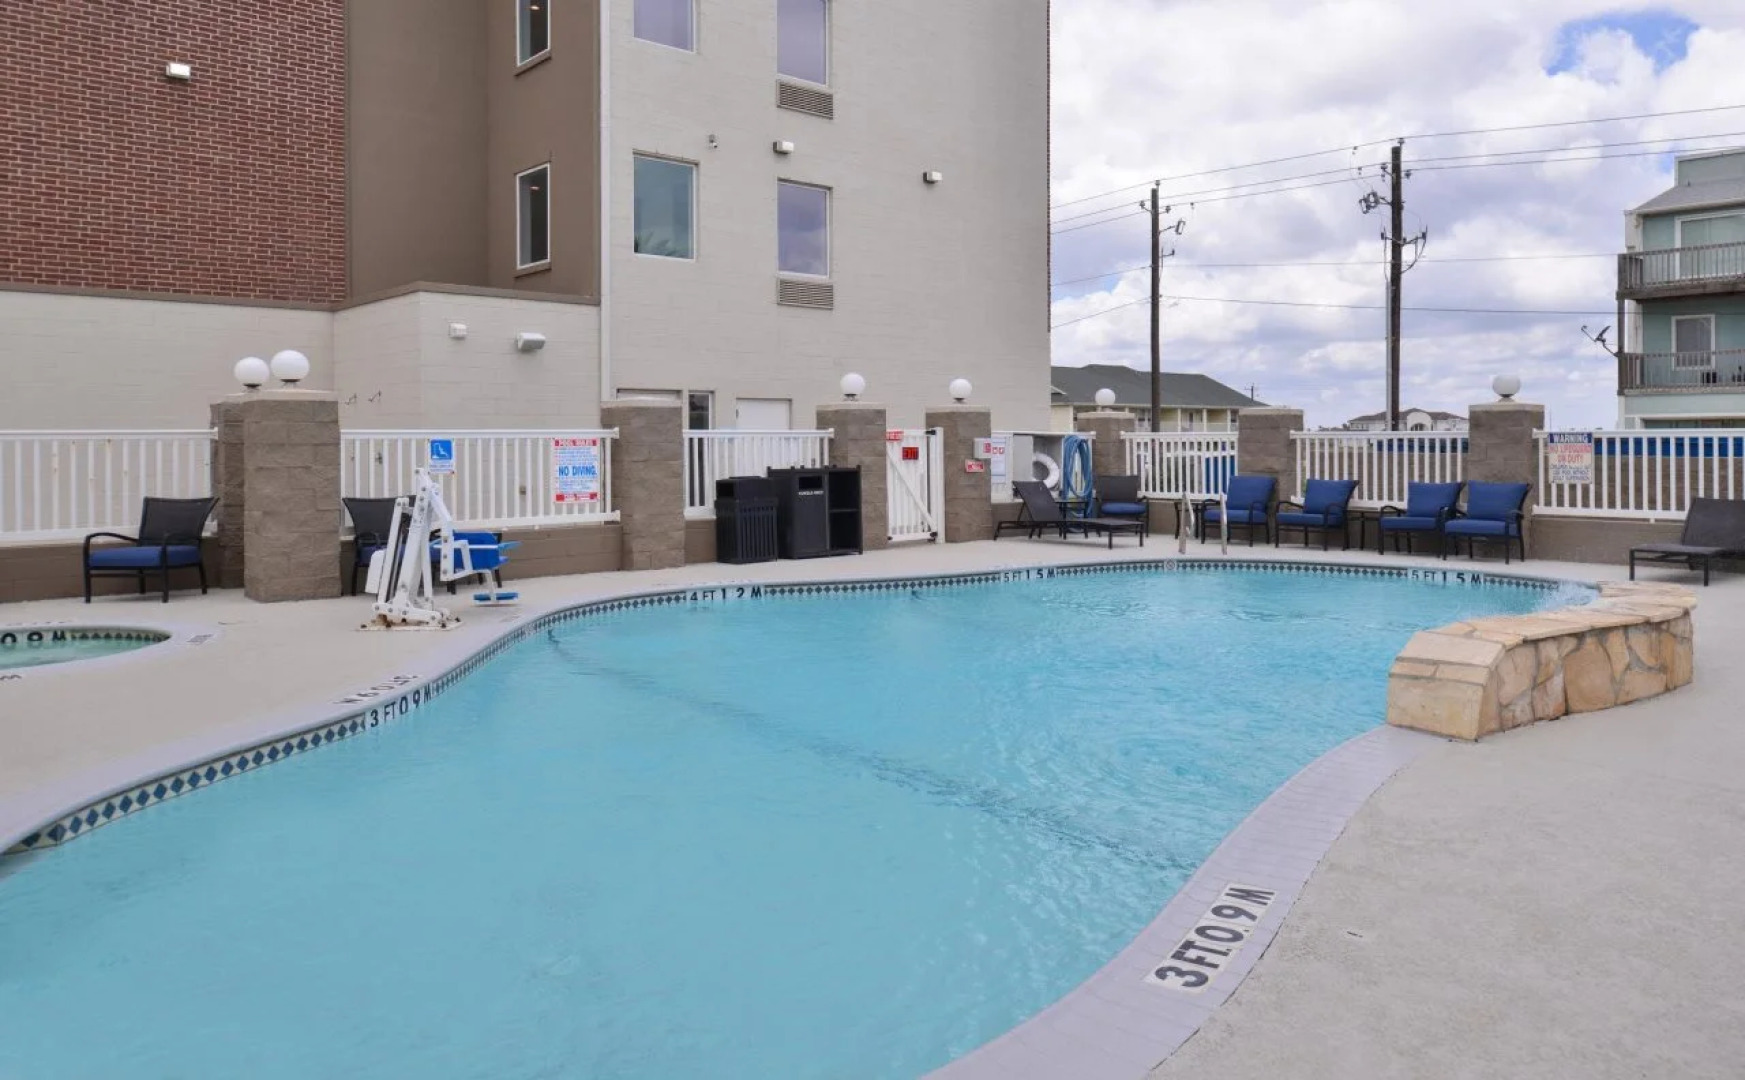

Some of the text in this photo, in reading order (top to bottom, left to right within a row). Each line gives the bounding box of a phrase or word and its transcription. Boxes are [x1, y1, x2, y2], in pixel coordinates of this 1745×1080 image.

[1553, 433, 1589, 443] WARNING
[558, 466, 570, 477] NO
[703, 589, 716, 601] FT
[370, 708, 379, 728] 3
[384, 700, 396, 724] FT
[1154, 965, 1209, 988] 3
[1224, 887, 1276, 906] M
